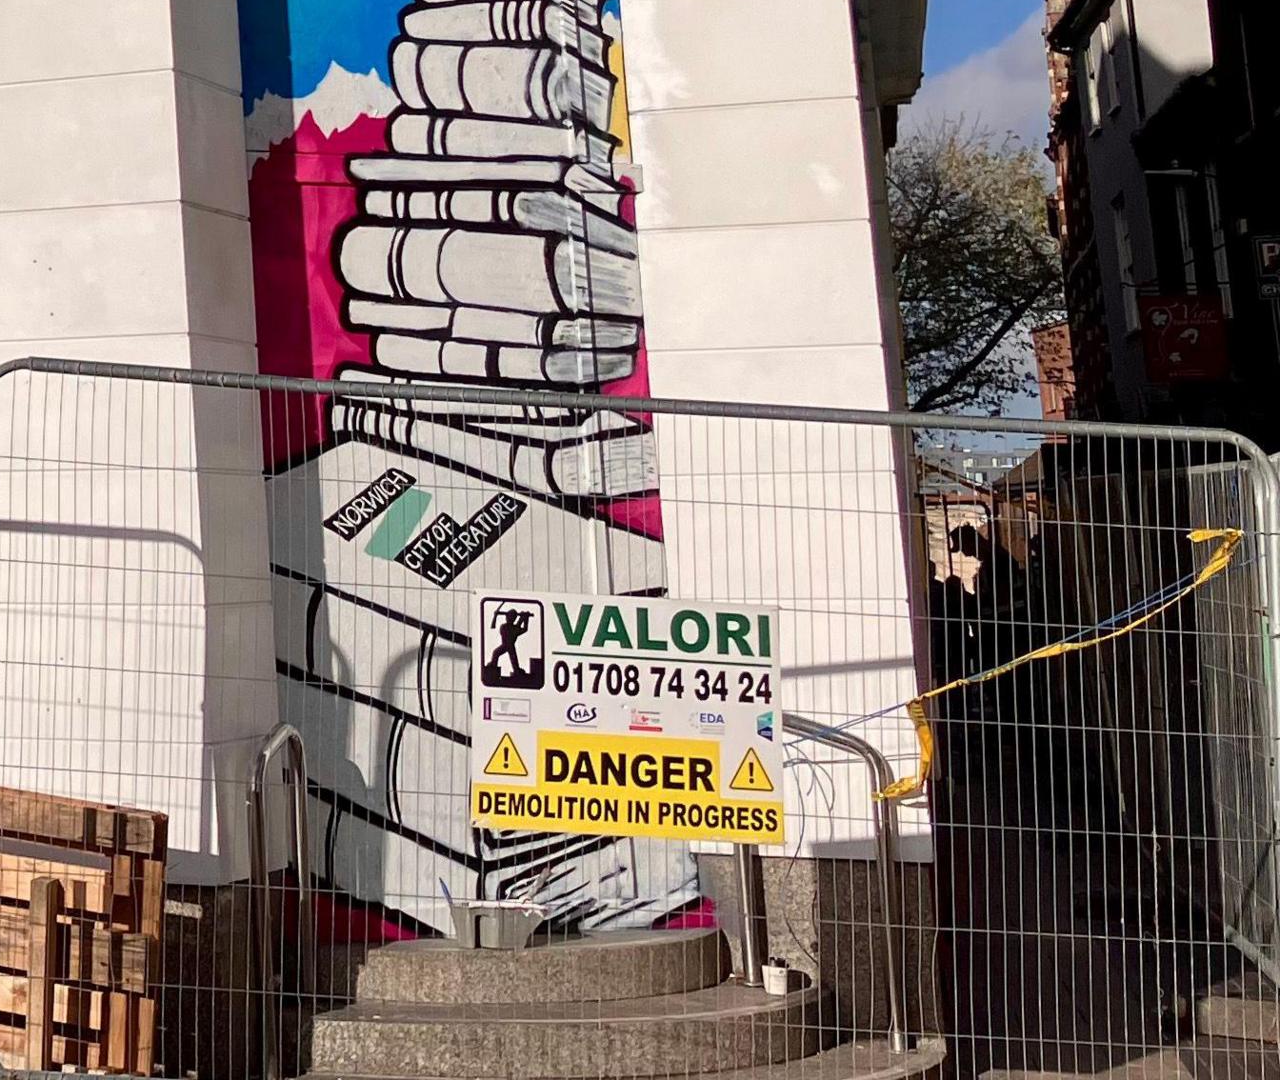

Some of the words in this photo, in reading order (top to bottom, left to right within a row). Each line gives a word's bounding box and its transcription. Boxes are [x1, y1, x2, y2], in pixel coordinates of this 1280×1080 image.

[332, 470, 408, 536] NORWICH
[404, 531, 433, 570] CITY
[431, 516, 454, 542] OF
[427, 494, 518, 583] LITERATURE
[552, 602, 772, 658] VALORI
[553, 660, 640, 697] 01708
[650, 667, 685, 699] 74
[694, 669, 728, 702] 34
[738, 672, 772, 704] 24
[566, 702, 597, 723] CHAS
[699, 712, 725, 725] EDA
[544, 748, 715, 792] DANGER
[478, 791, 618, 823] DEMOLITION
[628, 801, 649, 825] IN
[659, 802, 778, 832] PROGRESS
